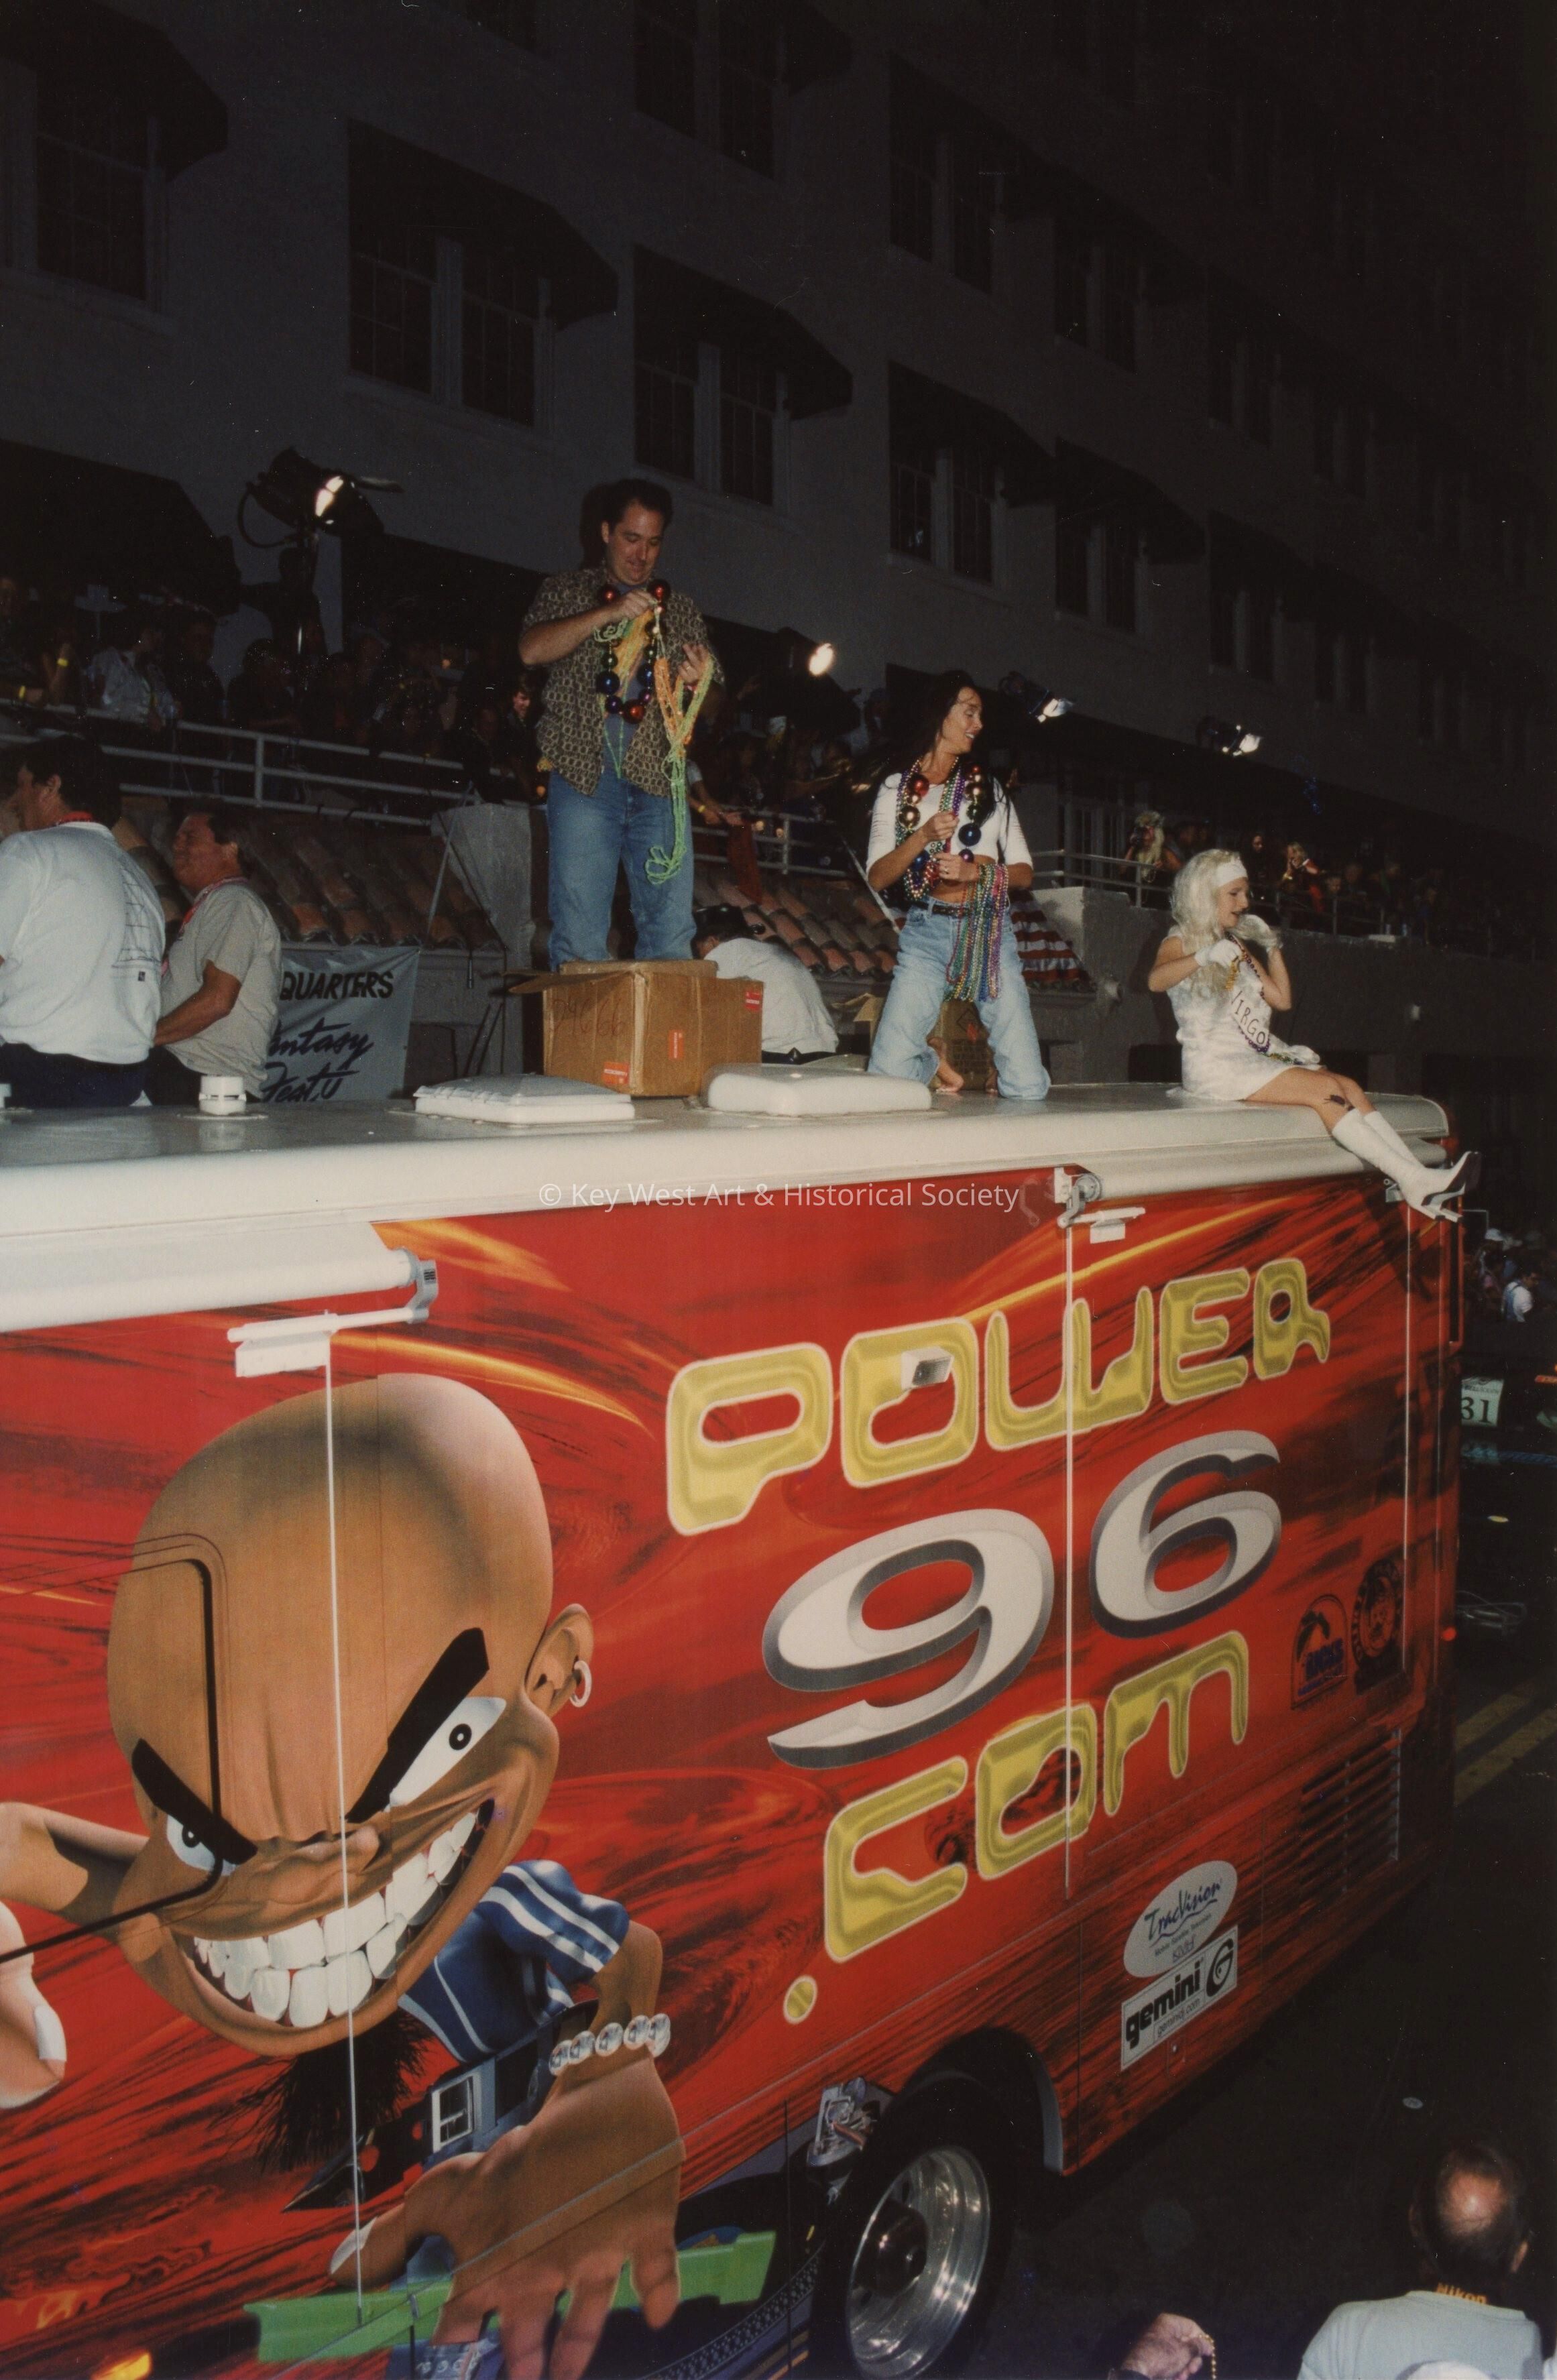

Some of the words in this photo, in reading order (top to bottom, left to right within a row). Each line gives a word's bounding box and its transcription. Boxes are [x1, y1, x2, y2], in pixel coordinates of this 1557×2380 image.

[268, 1018, 374, 1071] antasy
[667, 1258, 1331, 1536] POWER
[762, 1429, 1282, 1770] 96
[1144, 1881, 1221, 1940] TracVision
[1126, 1960, 1200, 2050] gemini
[1436, 2282, 1487, 2304] Nikon
